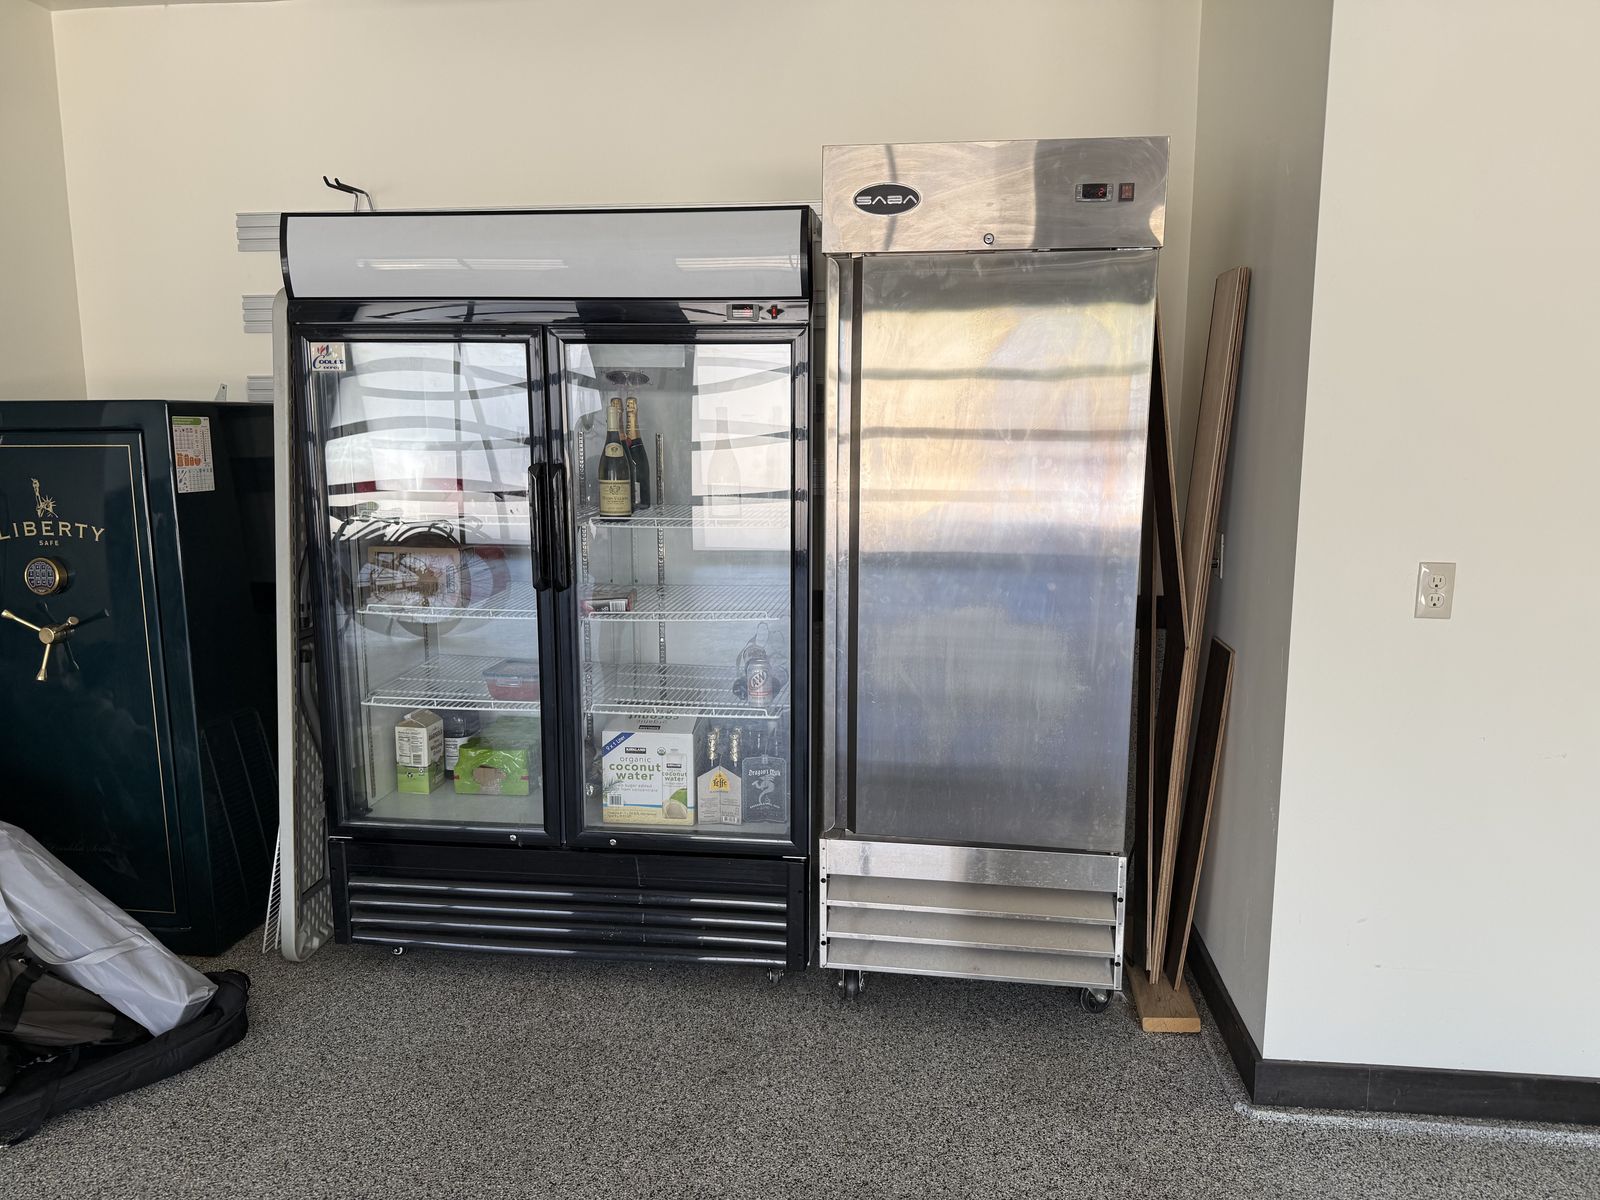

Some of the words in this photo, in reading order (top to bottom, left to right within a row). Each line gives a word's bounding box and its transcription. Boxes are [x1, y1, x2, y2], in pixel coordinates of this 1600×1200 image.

[856, 195, 918, 205] SABA
[0, 521, 105, 541] LIBERTY
[620, 756, 652, 764] organic
[609, 763, 662, 772] coconut
[616, 771, 654, 781] water
